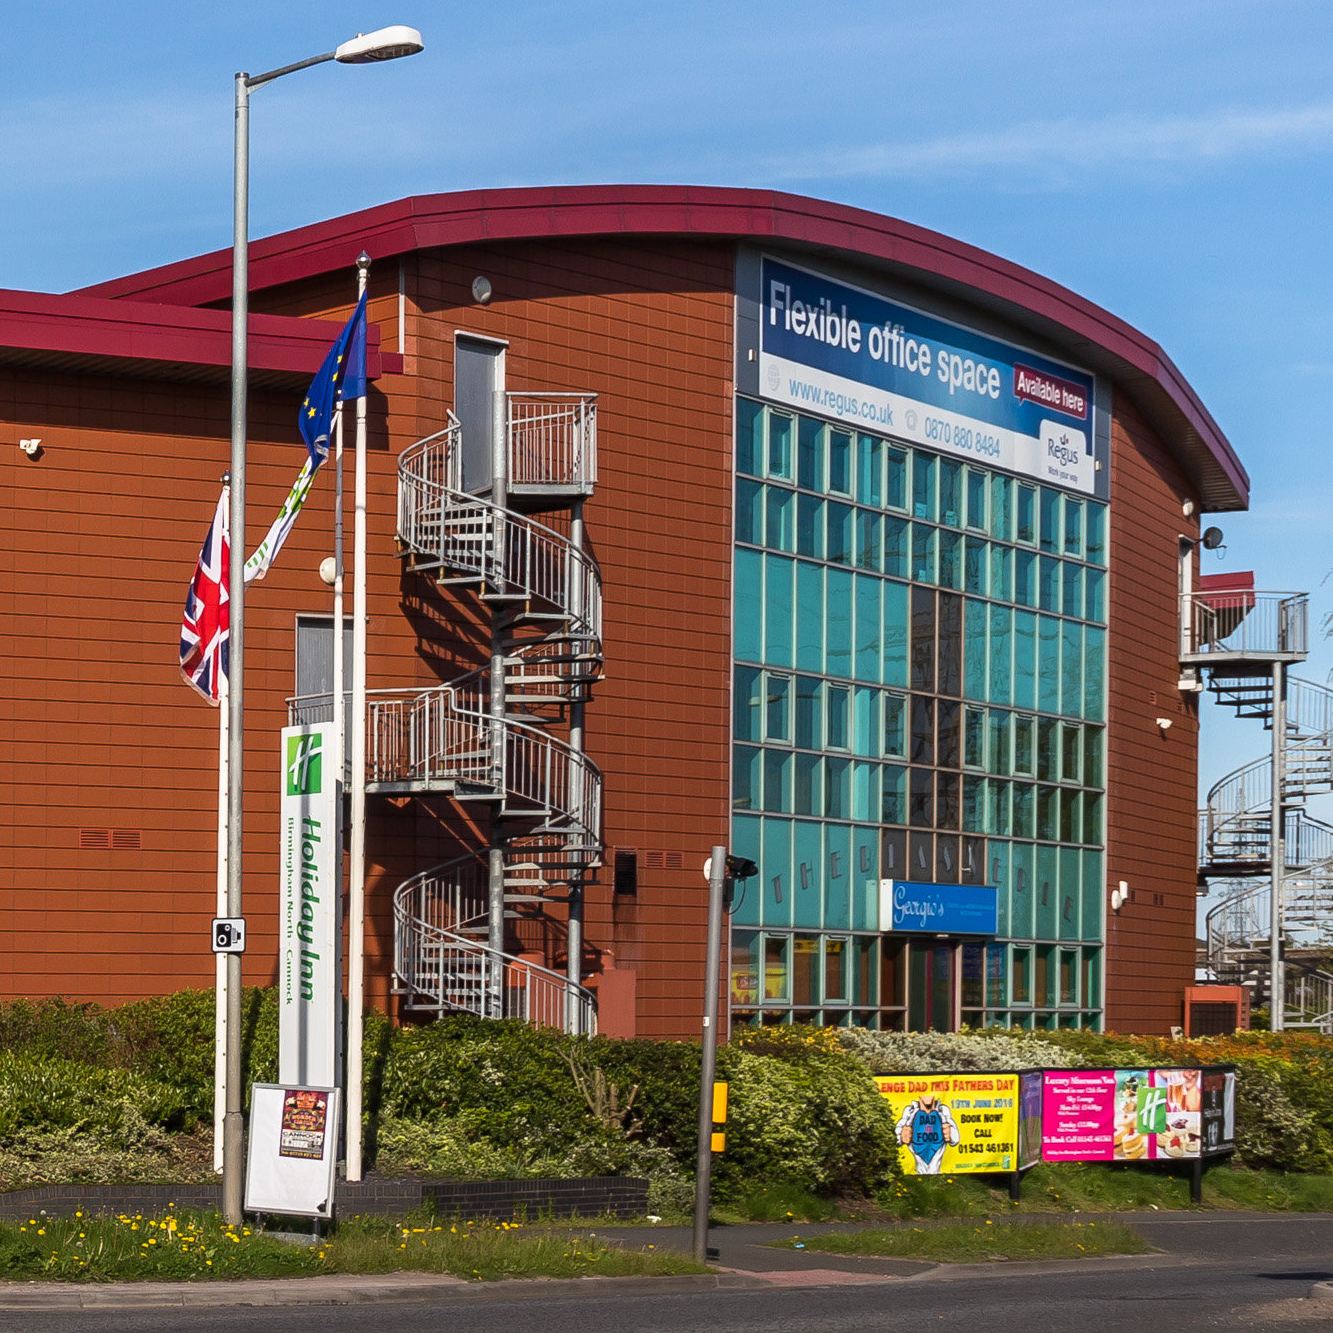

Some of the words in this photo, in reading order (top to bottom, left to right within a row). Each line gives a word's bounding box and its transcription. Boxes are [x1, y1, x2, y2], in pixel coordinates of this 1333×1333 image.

[770, 279, 862, 354] Flexible
[868, 320, 932, 376] office
[937, 350, 1001, 399] space
[1017, 369, 1061, 405] Available
[1062, 390, 1084, 413] here
[789, 377, 894, 427] www.regus.co.uk
[924, 417, 951, 442] 0870
[953, 425, 973, 450] 880
[975, 431, 1001, 457] 8484
[1047, 438, 1079, 466] Regus
[286, 817, 294, 898] Birmingham
[297, 815, 321, 944] Holiday
[300, 949, 320, 1001] Inn
[996, 1079, 1015, 1091] DAY
[919, 1115, 937, 1125] DAD
[974, 1129, 992, 1138] CALL
